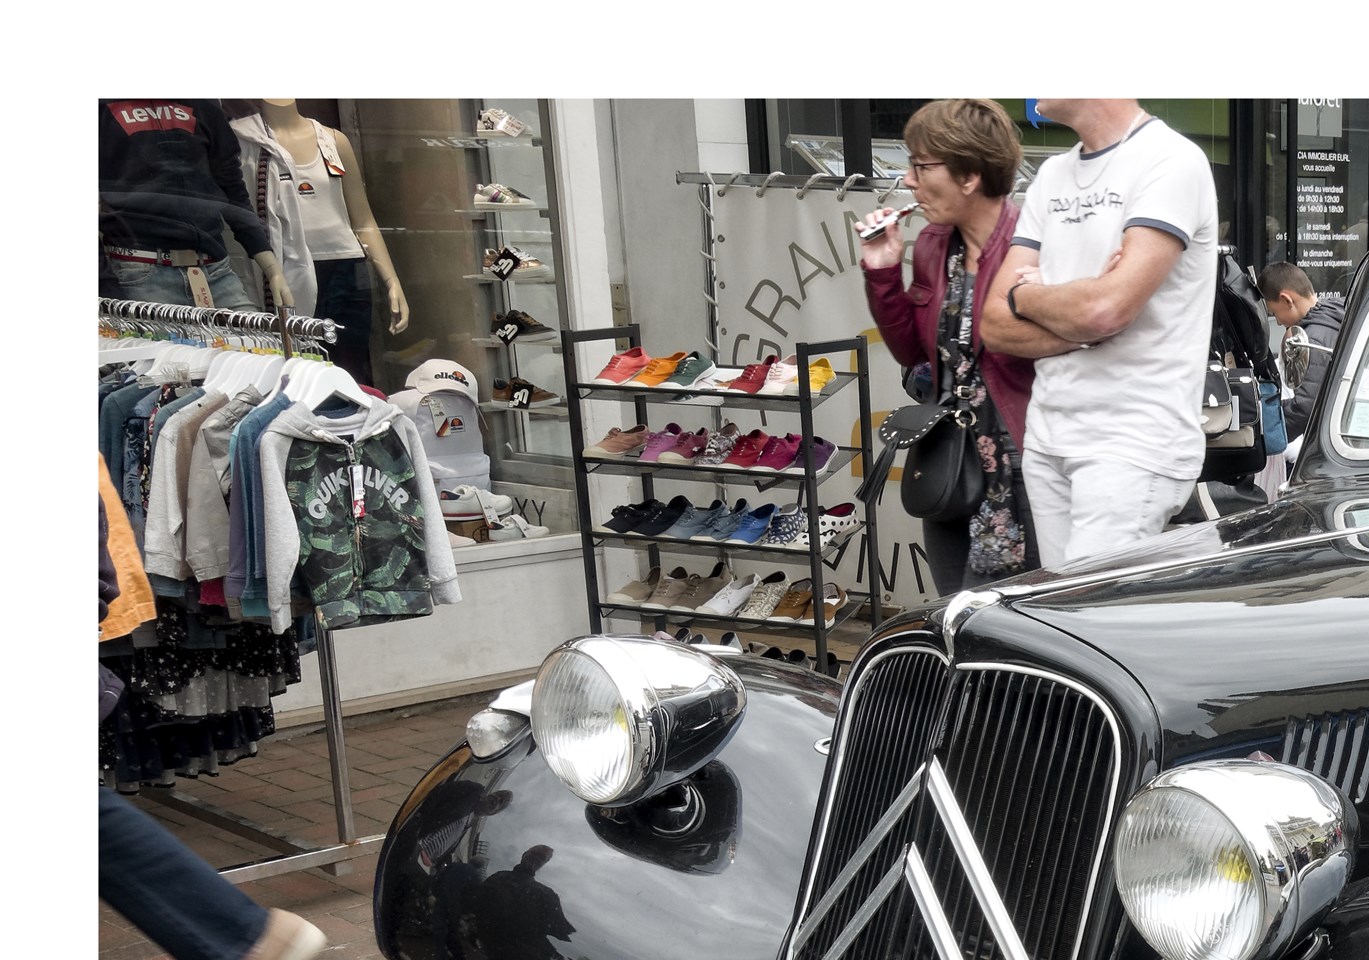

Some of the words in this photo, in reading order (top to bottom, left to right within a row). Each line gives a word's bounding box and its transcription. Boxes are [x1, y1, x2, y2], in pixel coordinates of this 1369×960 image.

[1308, 152, 1337, 161] IMMOBILIER
[1315, 164, 1336, 172] accueille
[1322, 185, 1344, 194] vendredi
[1297, 194, 1305, 202] de
[1324, 195, 1340, 203] 12h30
[1312, 222, 1331, 231] samedi
[1332, 232, 1360, 242] interruption
[1309, 249, 1334, 258] dimanche
[1323, 260, 1353, 269] uniquement
[308, 465, 410, 520] QUIKLVER
